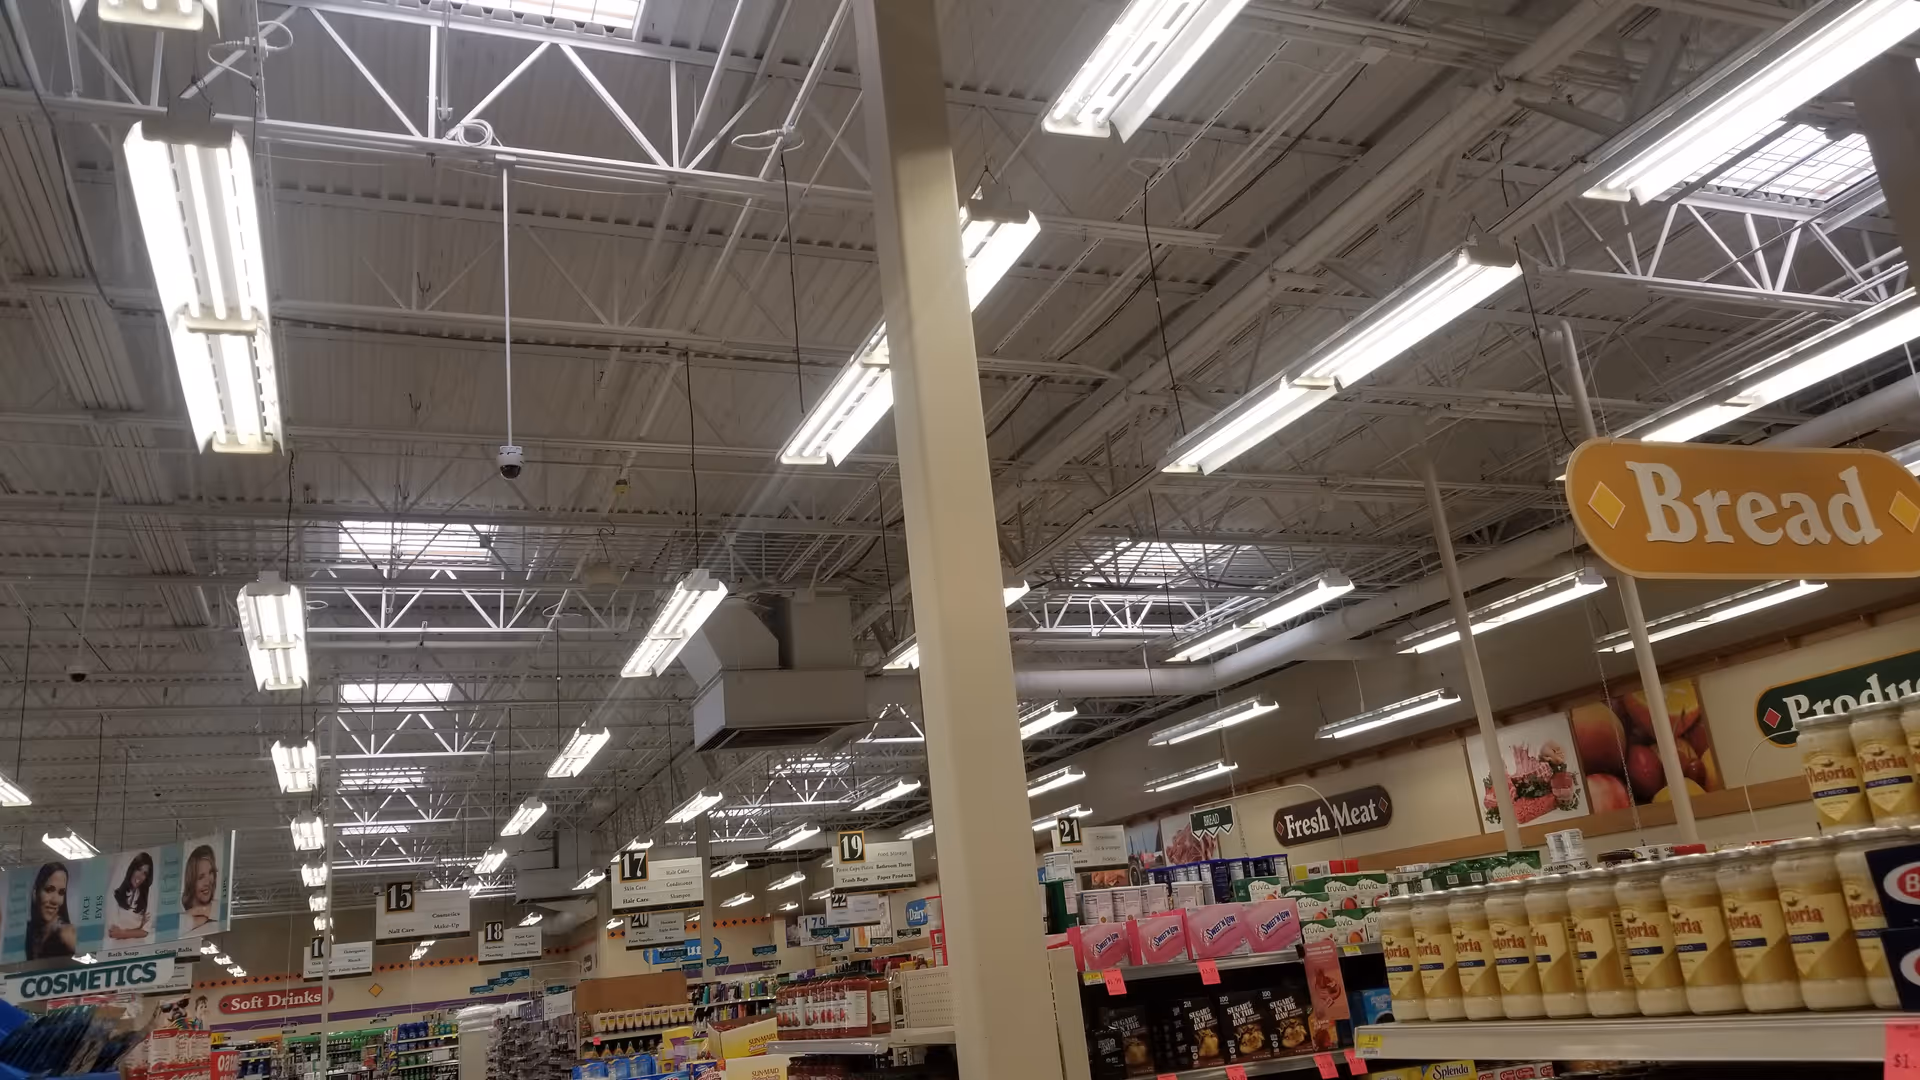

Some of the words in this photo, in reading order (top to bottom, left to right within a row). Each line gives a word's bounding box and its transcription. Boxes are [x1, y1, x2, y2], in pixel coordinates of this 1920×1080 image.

[1625, 461, 1883, 545] Bread
[1782, 673, 1920, 731] Produ
[1203, 813, 1220, 827] BREAD
[1284, 813, 1331, 840] Fresh
[1333, 798, 1379, 830] Meat
[1059, 819, 1080, 842] 21
[840, 834, 863, 860] 19
[621, 852, 646, 879] 17
[388, 884, 412, 910] 15
[832, 893, 846, 907] 22
[94, 895, 103, 919] EYES
[432, 911, 461, 919] Cosmetics
[909, 906, 924, 923] Dairy
[631, 913, 648, 927] 20
[486, 922, 503, 941] 18
[20, 962, 157, 999] COSMETICS
[231, 994, 264, 1011] Soft
[268, 991, 322, 1008] Drinks
[1275, 1005, 1283, 1014] IN
[1282, 1002, 1297, 1012] THE
[1194, 1015, 1201, 1024] IN
[1200, 1012, 1213, 1022] THE
[1232, 1010, 1241, 1019] IN
[1240, 1006, 1255, 1017] THE
[1274, 1012, 1289, 1021] RAW
[1194, 1021, 1206, 1031] RAW
[1232, 1017, 1246, 1027] RAW
[1432, 1063, 1469, 1080] Splenda
